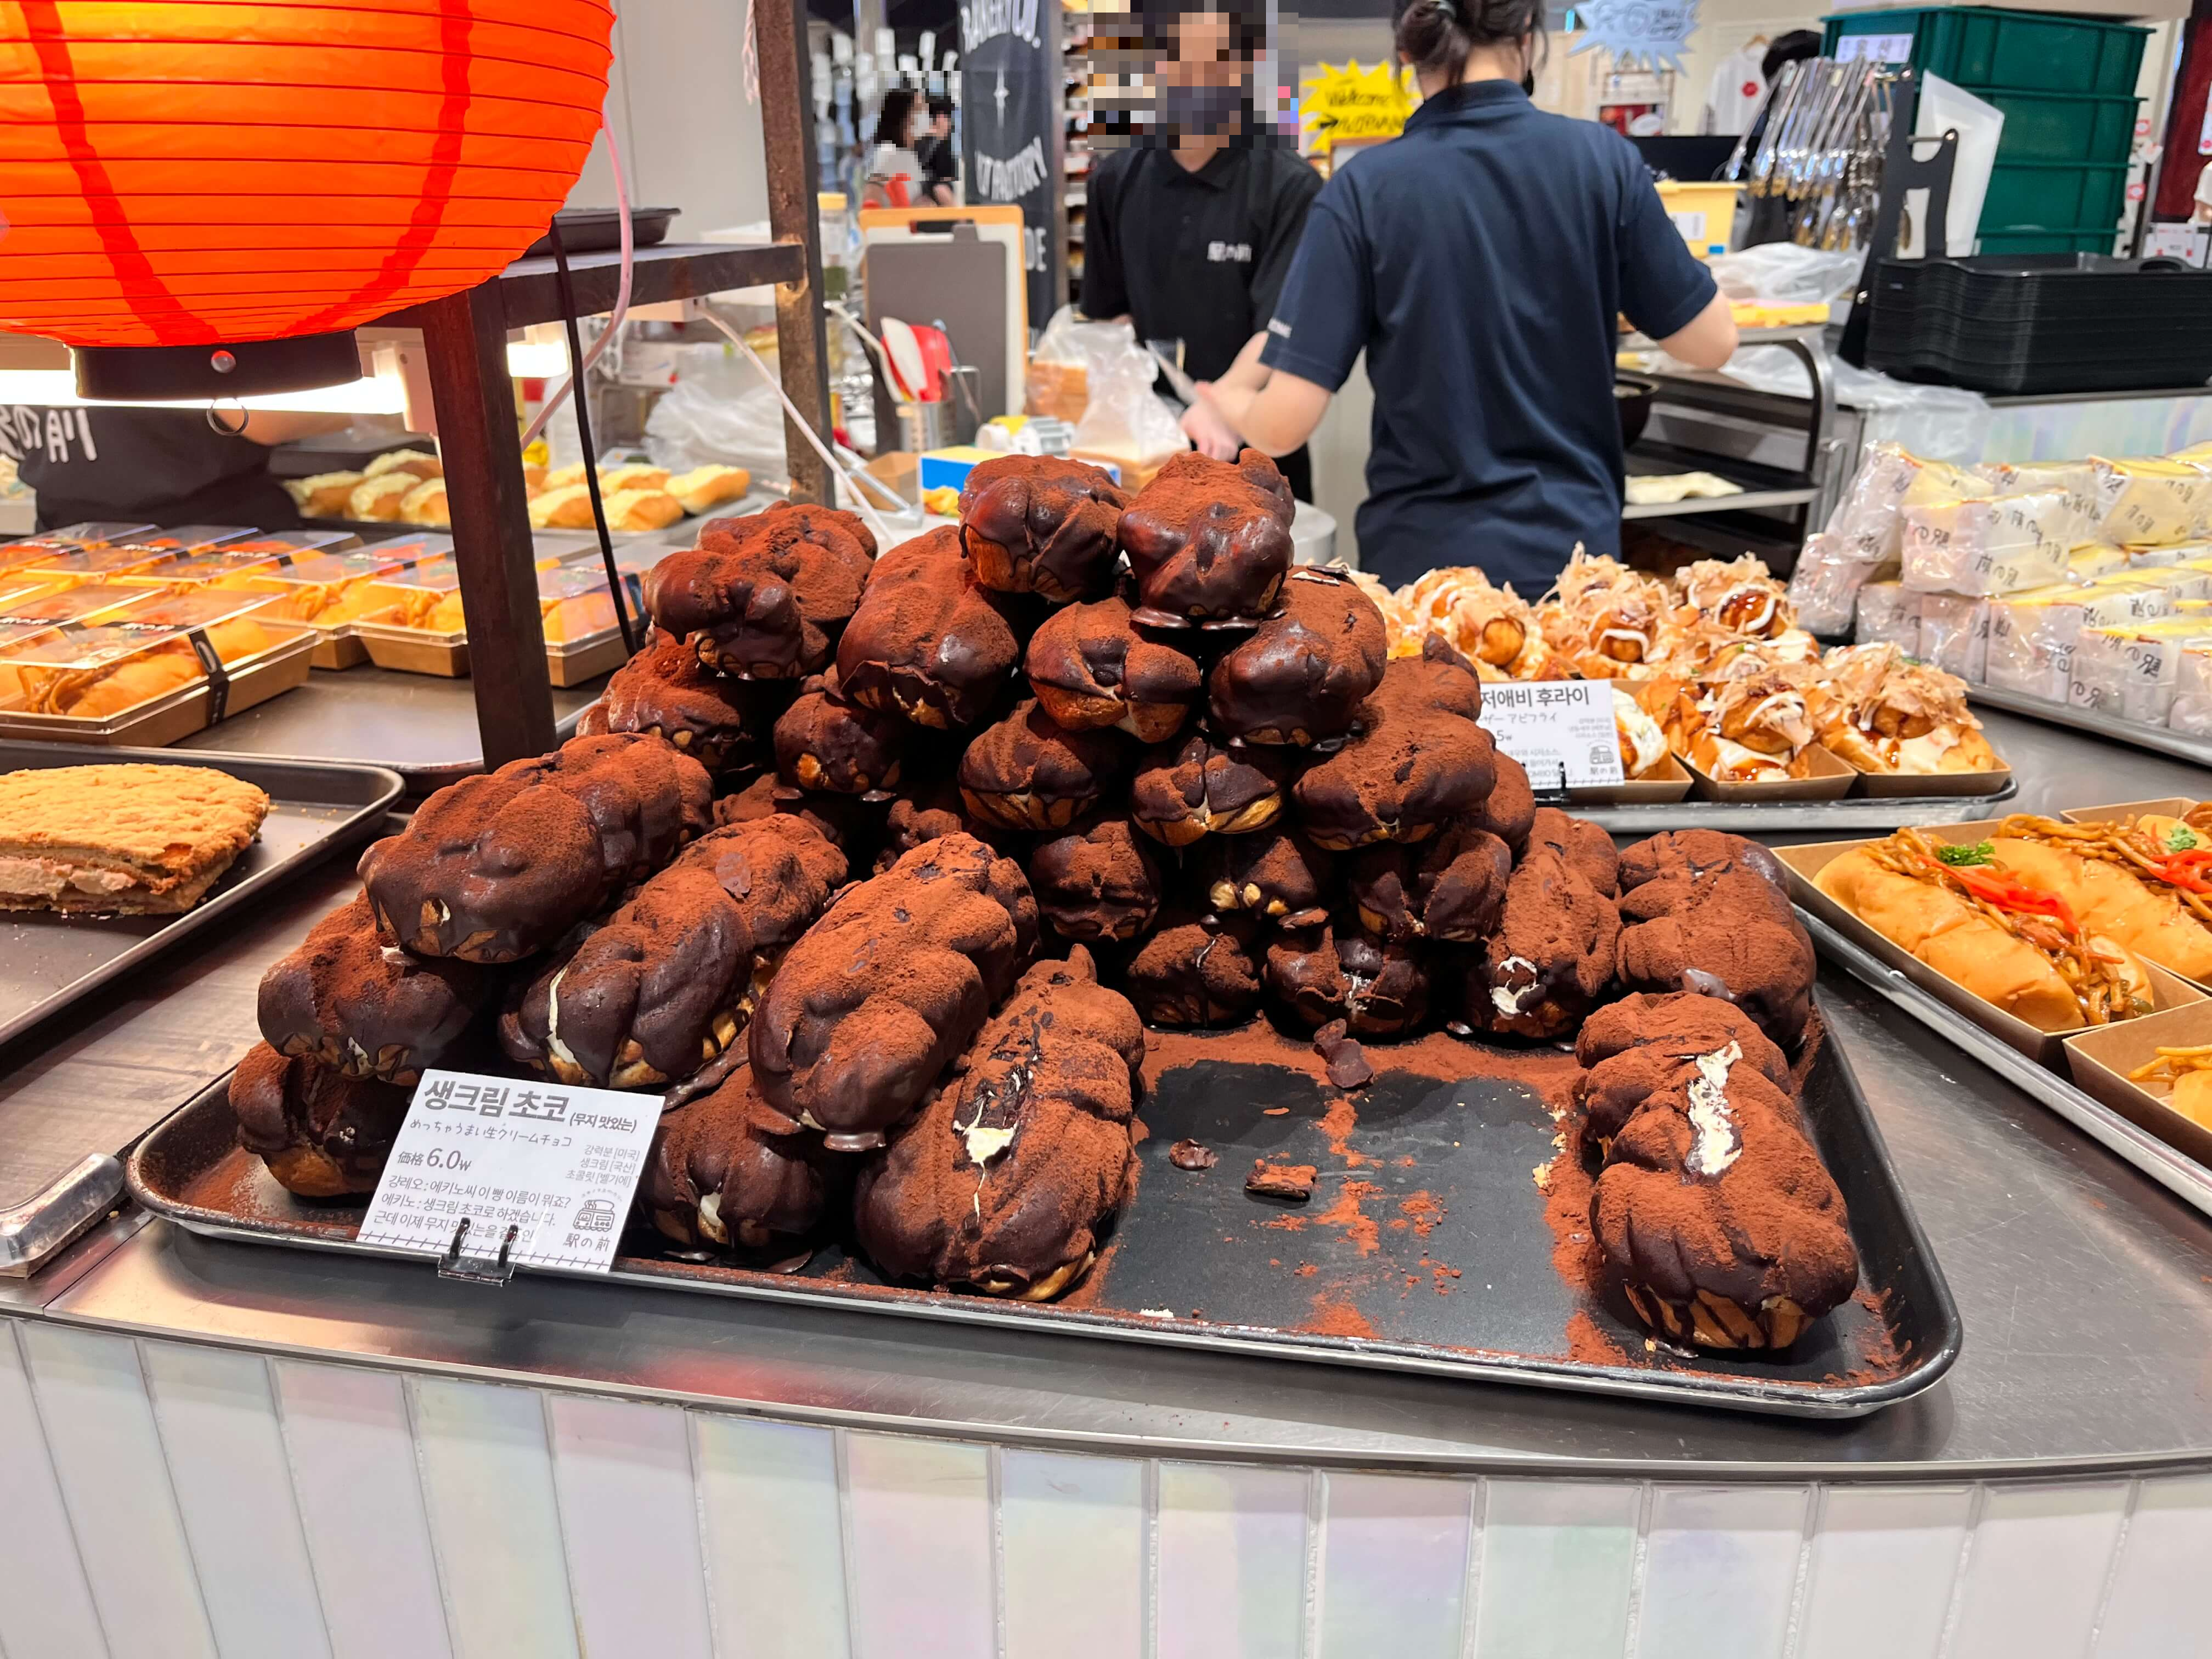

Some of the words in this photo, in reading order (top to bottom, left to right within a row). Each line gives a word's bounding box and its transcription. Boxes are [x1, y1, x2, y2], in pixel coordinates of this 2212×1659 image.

[1536, 686, 1590, 706] 후라이
[424, 1080, 510, 1118] 생크림
[509, 1090, 569, 1122] 초코
[570, 1112, 598, 1128] (무지
[598, 1115, 637, 1133] 맛있는)
[397, 1151, 424, 1166] 価格
[585, 1144, 613, 1158] 강력분
[613, 1147, 640, 1162] [미국]
[580, 1158, 609, 1170] 생크림
[609, 1161, 636, 1175] [국산]
[566, 1169, 595, 1182] 초콜릿
[595, 1172, 632, 1188] [벨기에]
[430, 1180, 478, 1197] 에키노씨
[479, 1186, 491, 1200] 이
[493, 1188, 504, 1201] 빵
[505, 1189, 540, 1206] 이름이
[541, 1194, 571, 1208] 뭐죠?
[381, 1193, 415, 1207] 에키노
[423, 1197, 459, 1214] 생크림
[459, 1203, 495, 1218] 초코로
[497, 1206, 556, 1226] 하겠습니다.
[374, 1210, 399, 1226] 근데
[400, 1213, 425, 1229] 이제
[425, 1217, 449, 1231] 무지
